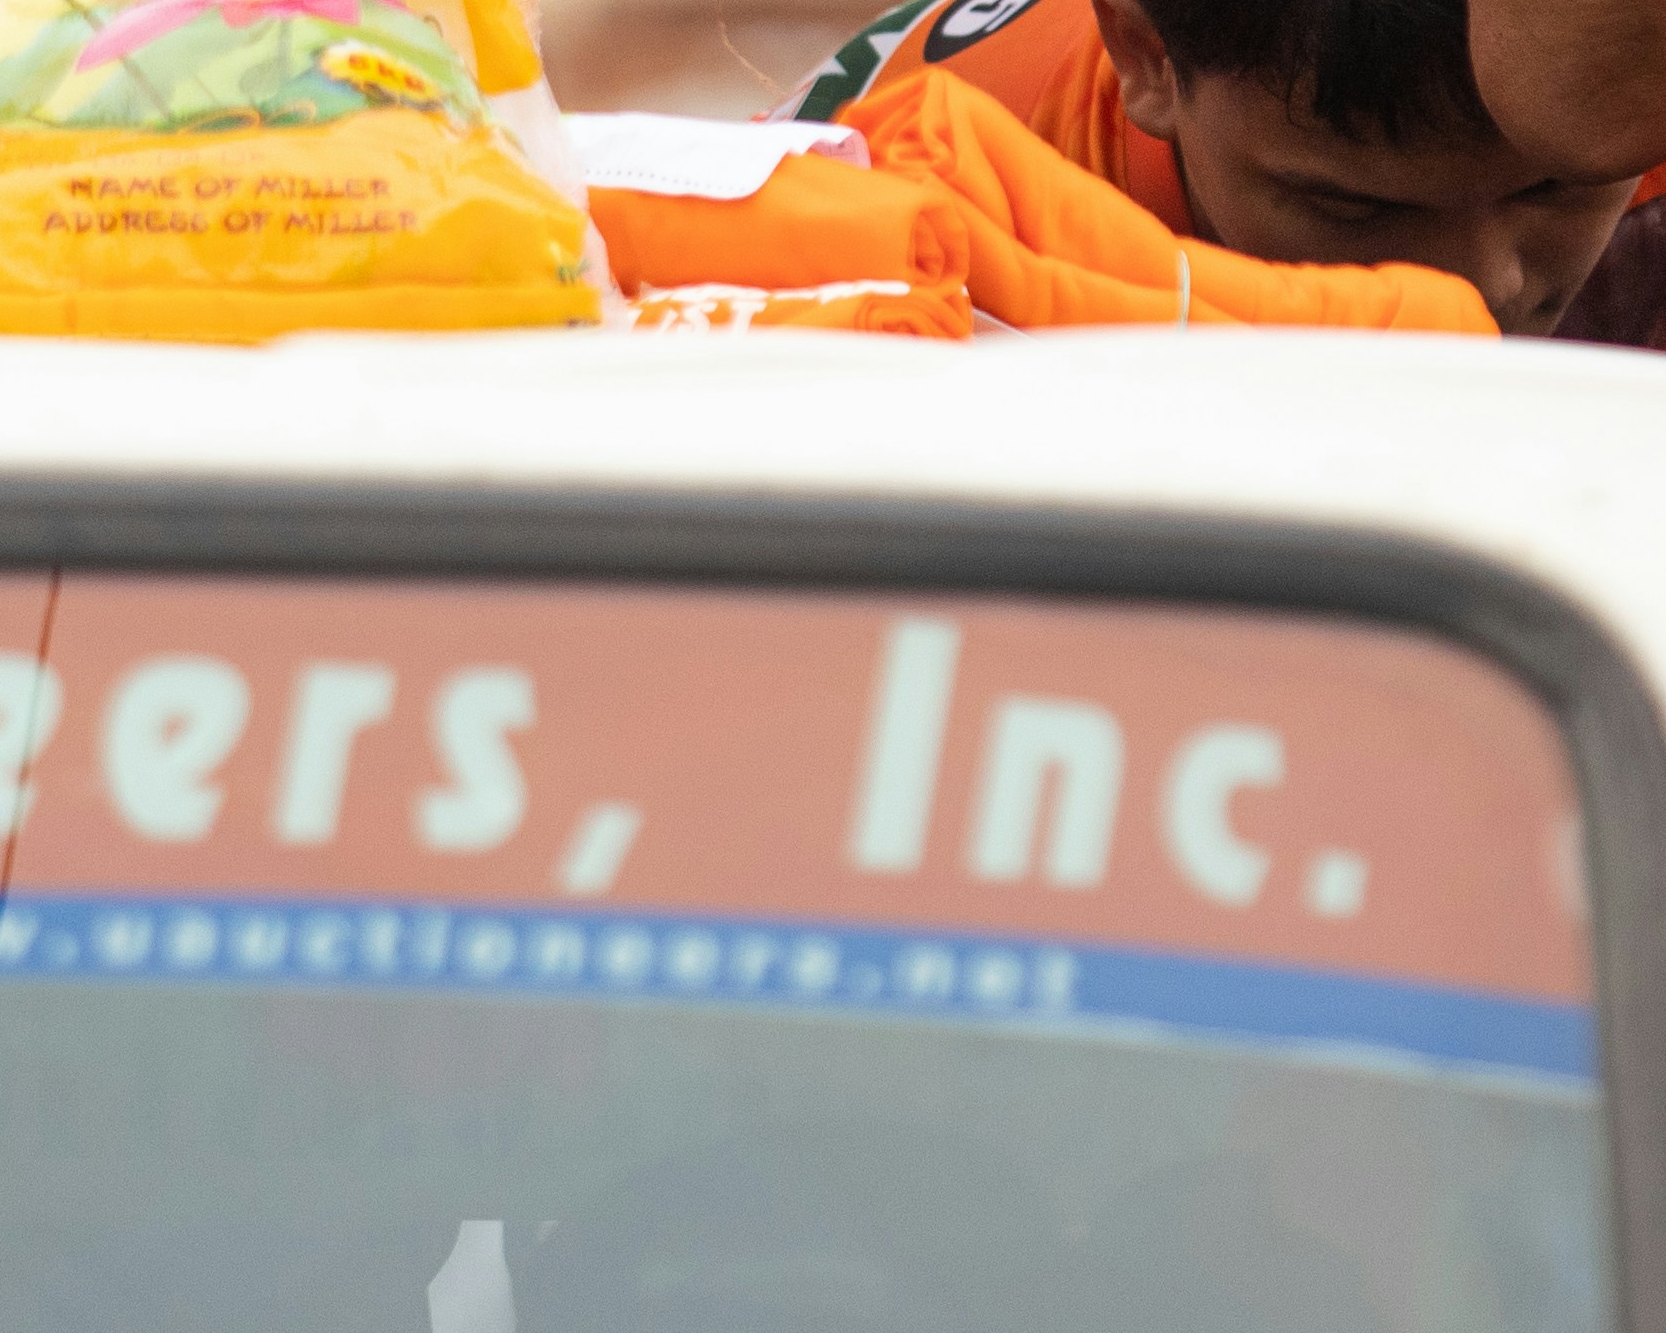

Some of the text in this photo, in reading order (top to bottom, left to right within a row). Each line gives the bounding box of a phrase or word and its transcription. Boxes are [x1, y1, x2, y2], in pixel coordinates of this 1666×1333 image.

[68, 175, 392, 202] NAME OF MILLER
[42, 208, 419, 234] ADDRESS OF MILLER
[847, 616, 1370, 917] Inc.
